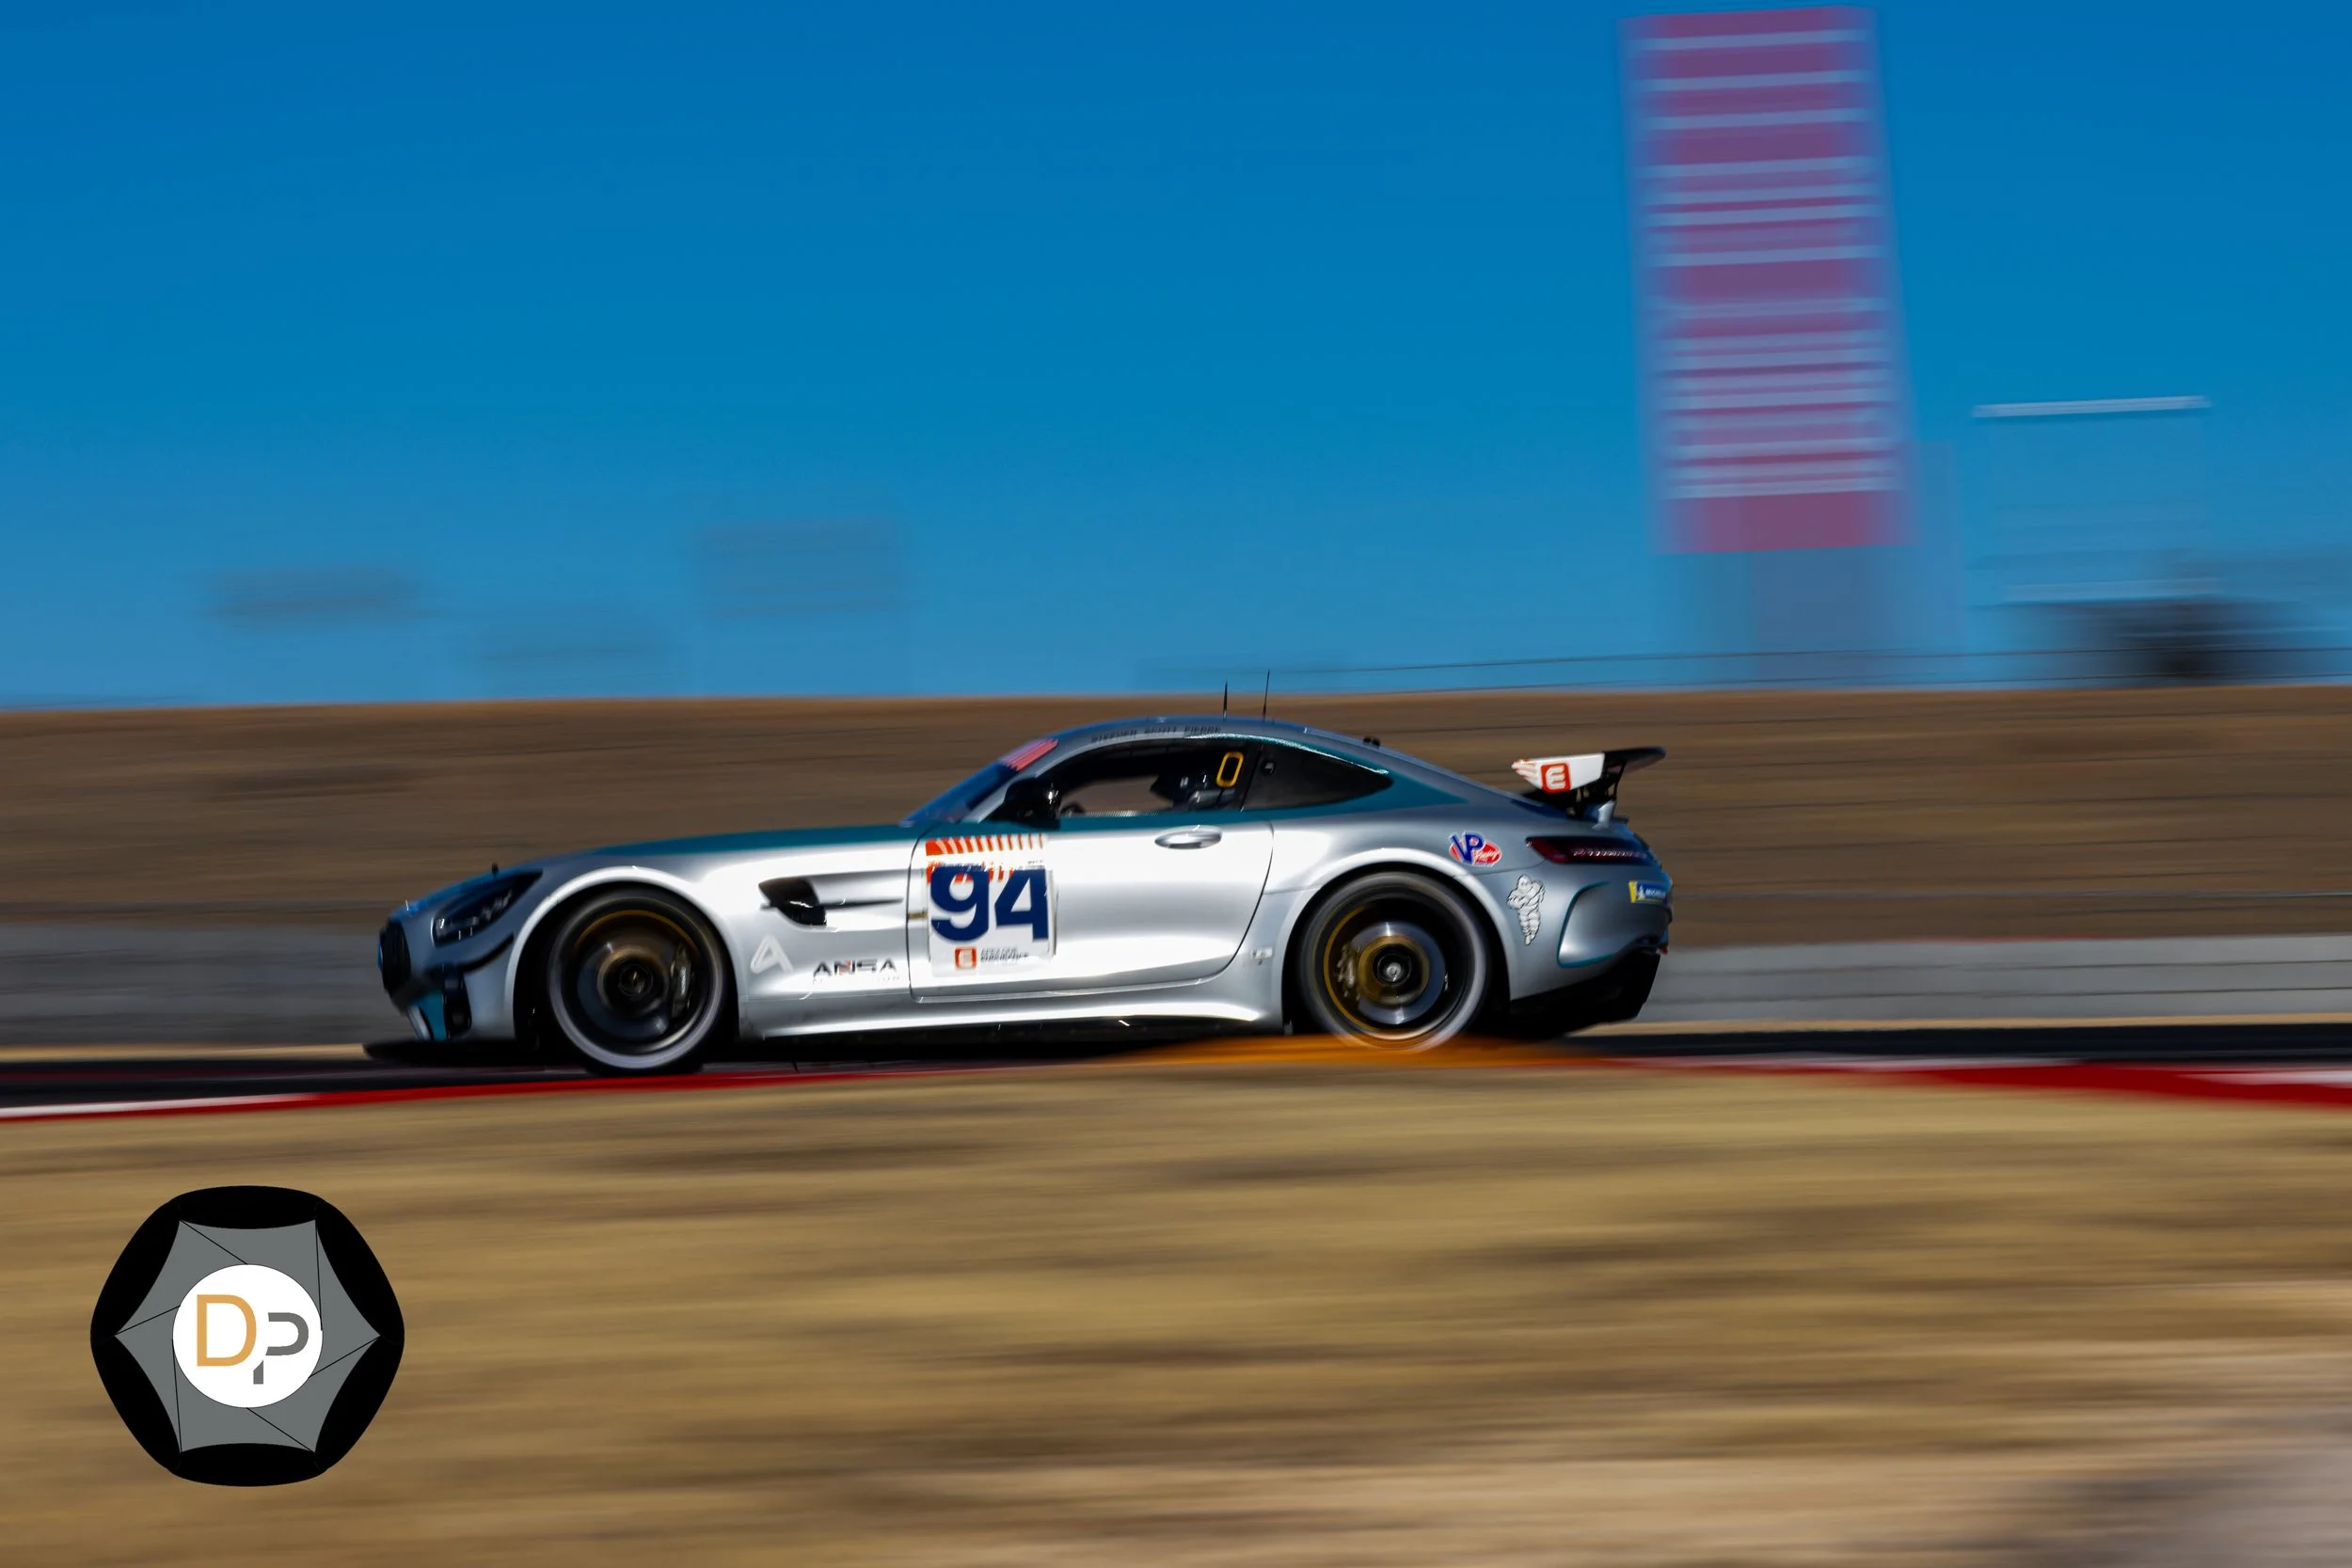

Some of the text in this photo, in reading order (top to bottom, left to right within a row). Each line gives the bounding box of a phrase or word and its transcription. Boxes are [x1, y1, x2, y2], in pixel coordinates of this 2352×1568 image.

[1449, 832, 1485, 863] VP
[930, 864, 1049, 958] 94
[813, 958, 897, 976] ANSA
